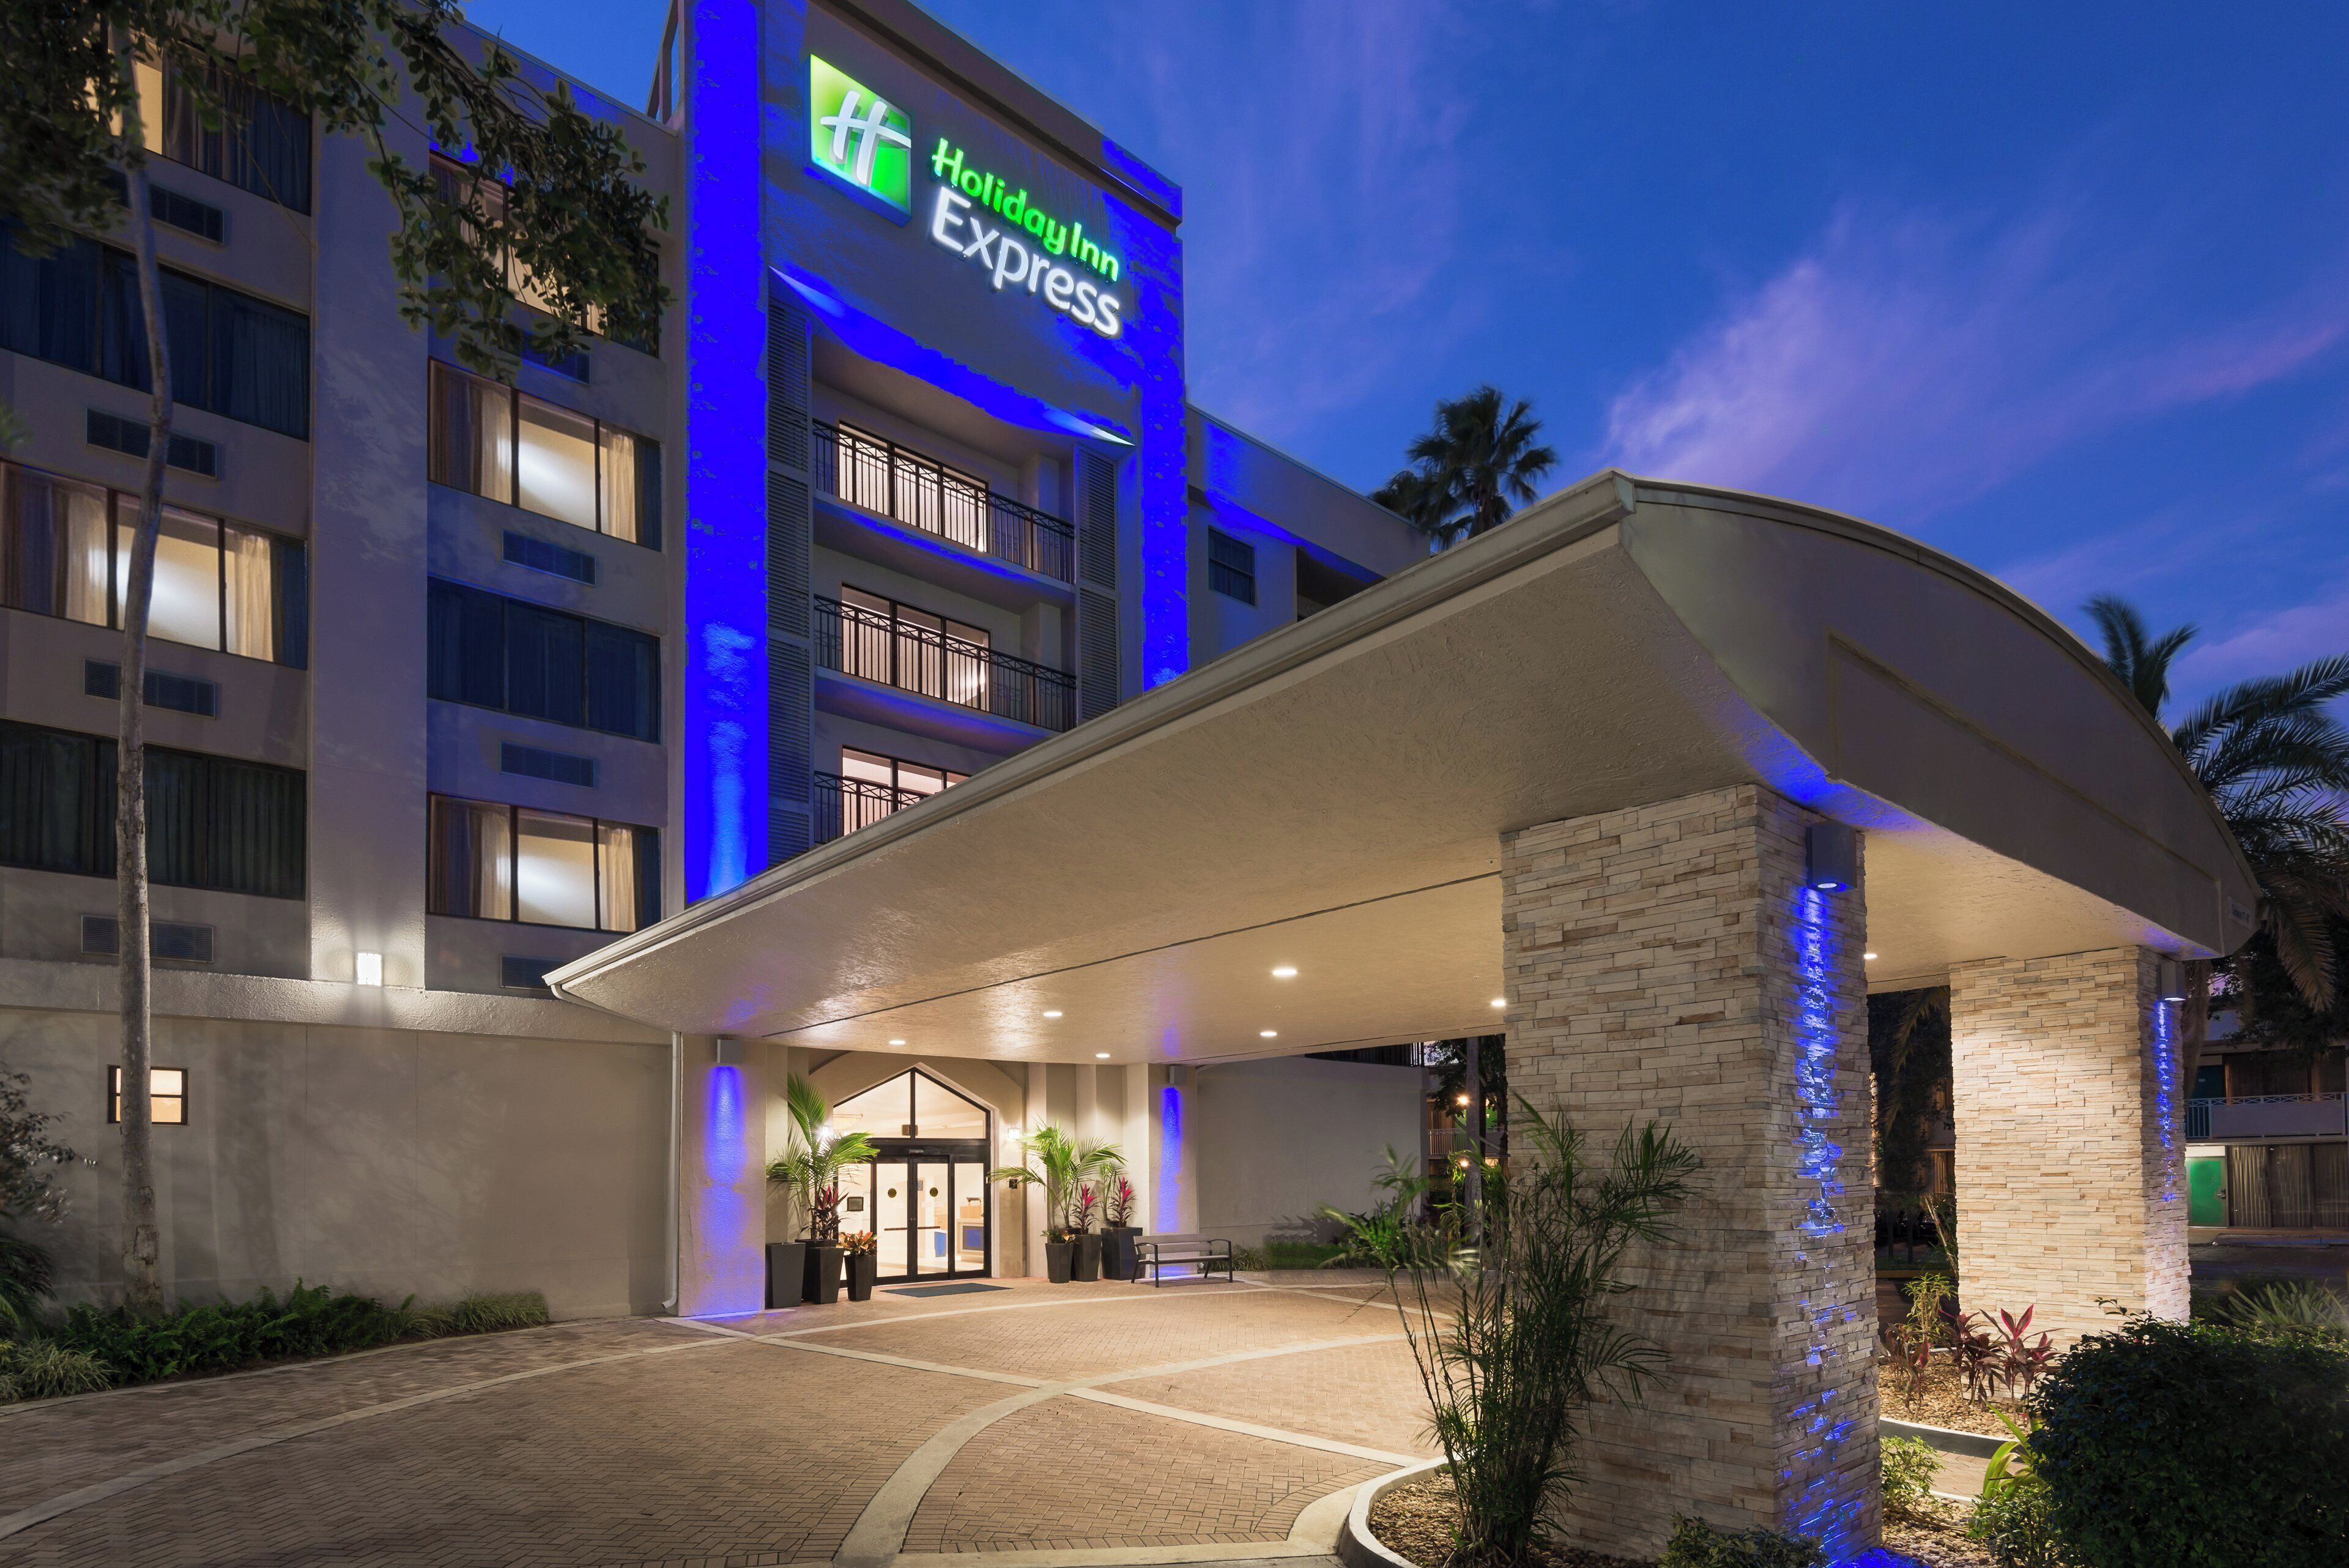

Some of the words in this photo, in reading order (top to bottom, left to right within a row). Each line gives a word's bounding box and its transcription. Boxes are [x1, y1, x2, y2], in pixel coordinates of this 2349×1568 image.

[931, 137, 1067, 255] Holiday
[1069, 221, 1119, 283] Inn
[932, 185, 1120, 336] Express
